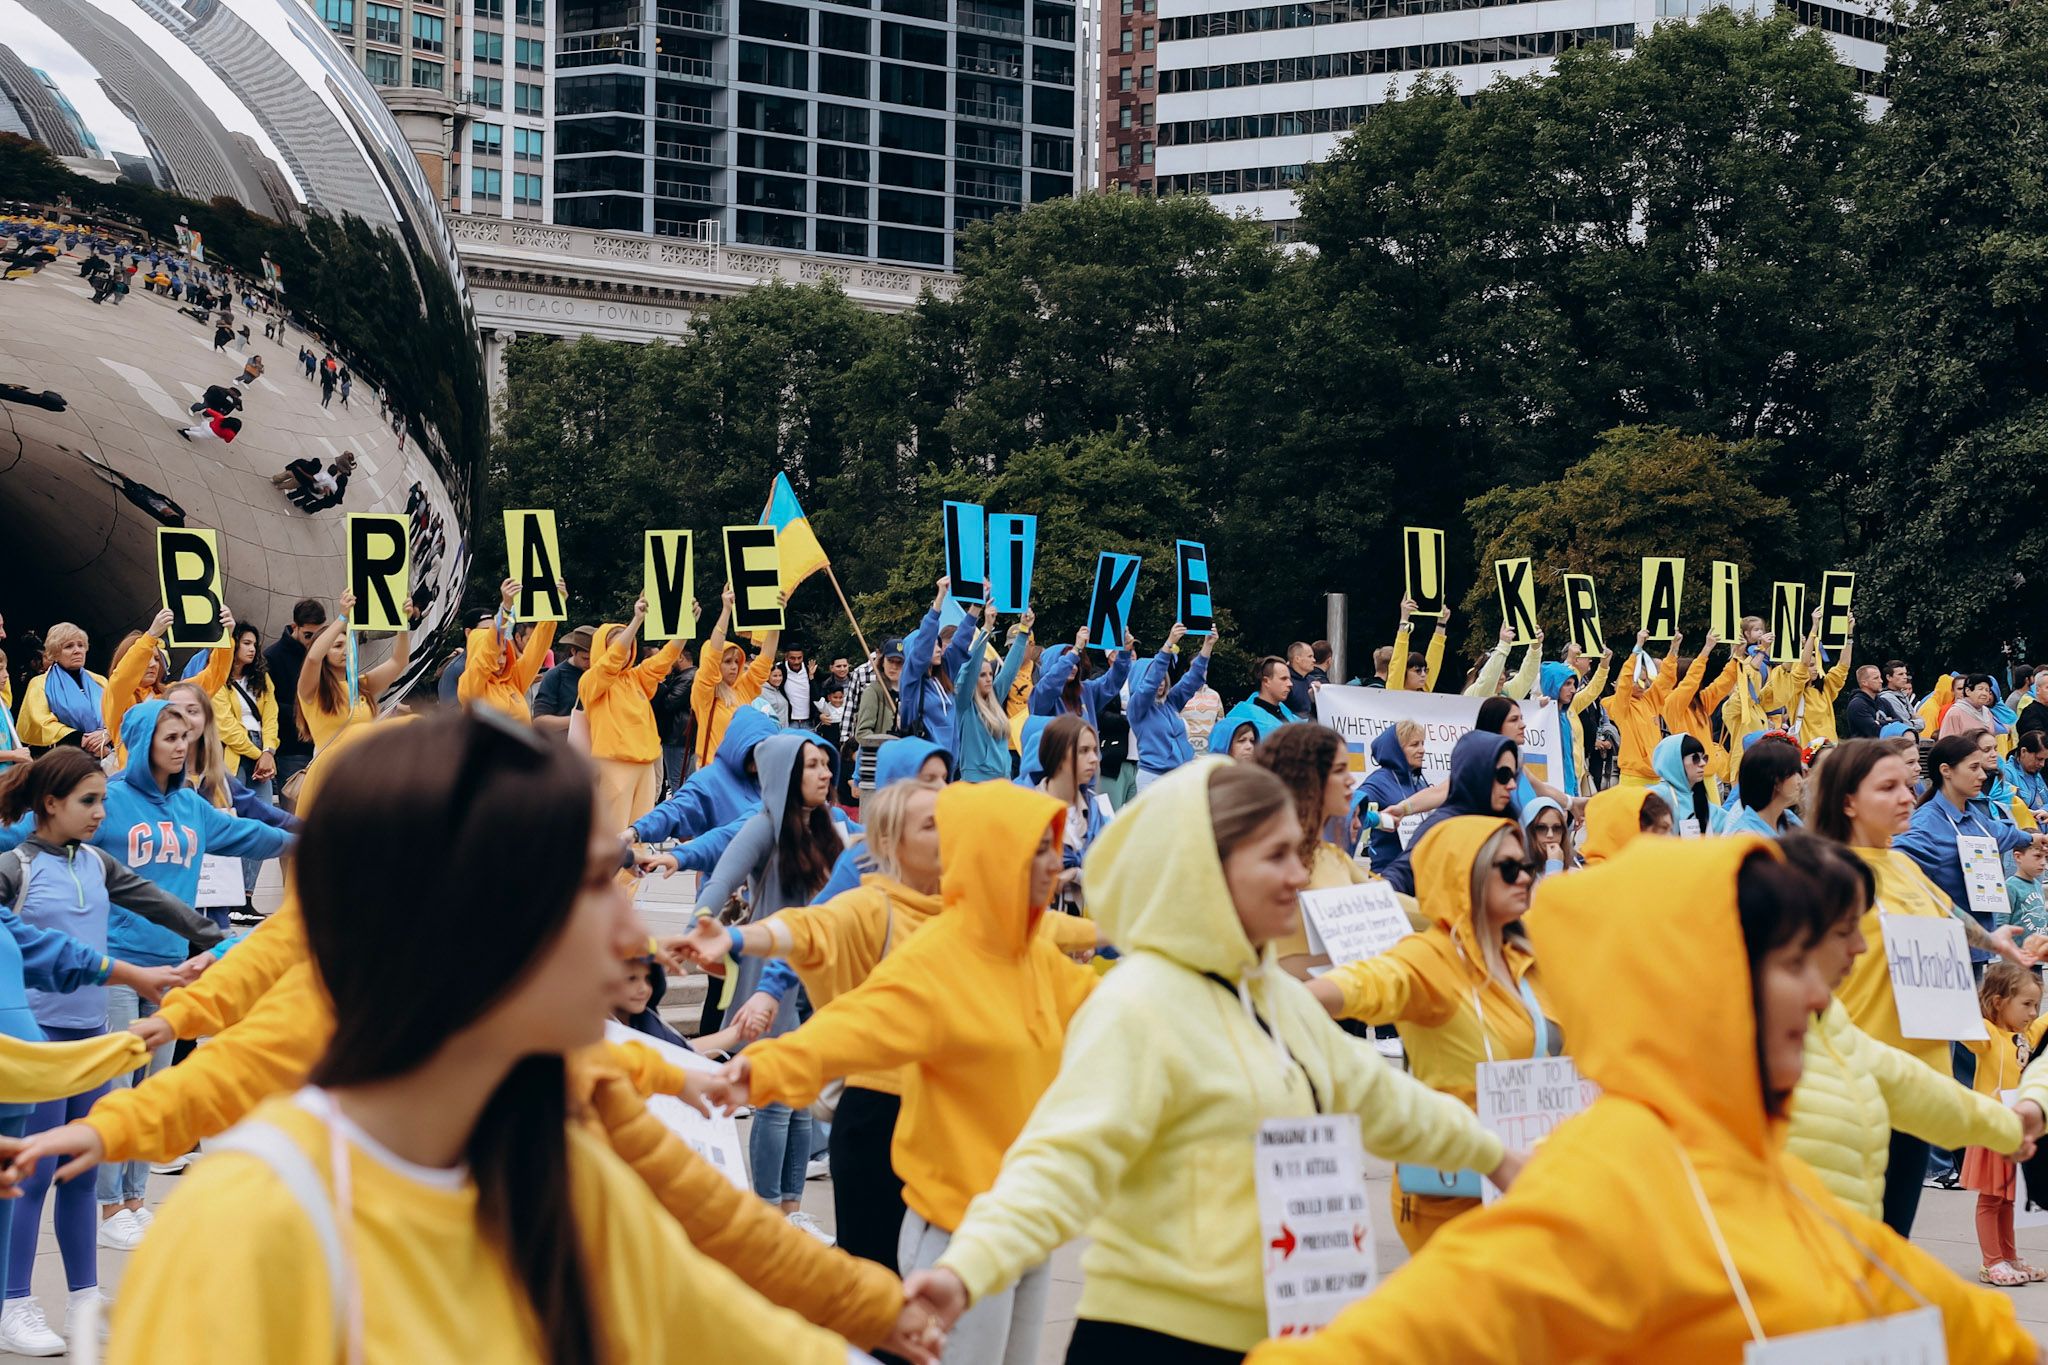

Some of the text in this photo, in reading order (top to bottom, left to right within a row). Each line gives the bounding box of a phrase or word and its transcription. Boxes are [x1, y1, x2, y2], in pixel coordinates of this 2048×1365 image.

[1439, 724, 1457, 742] OR
[127, 821, 198, 869] GAP
[1492, 1063, 1535, 1089] WANT
[1541, 1060, 1562, 1084] TO
[1536, 1085, 1574, 1111] ABOUT
